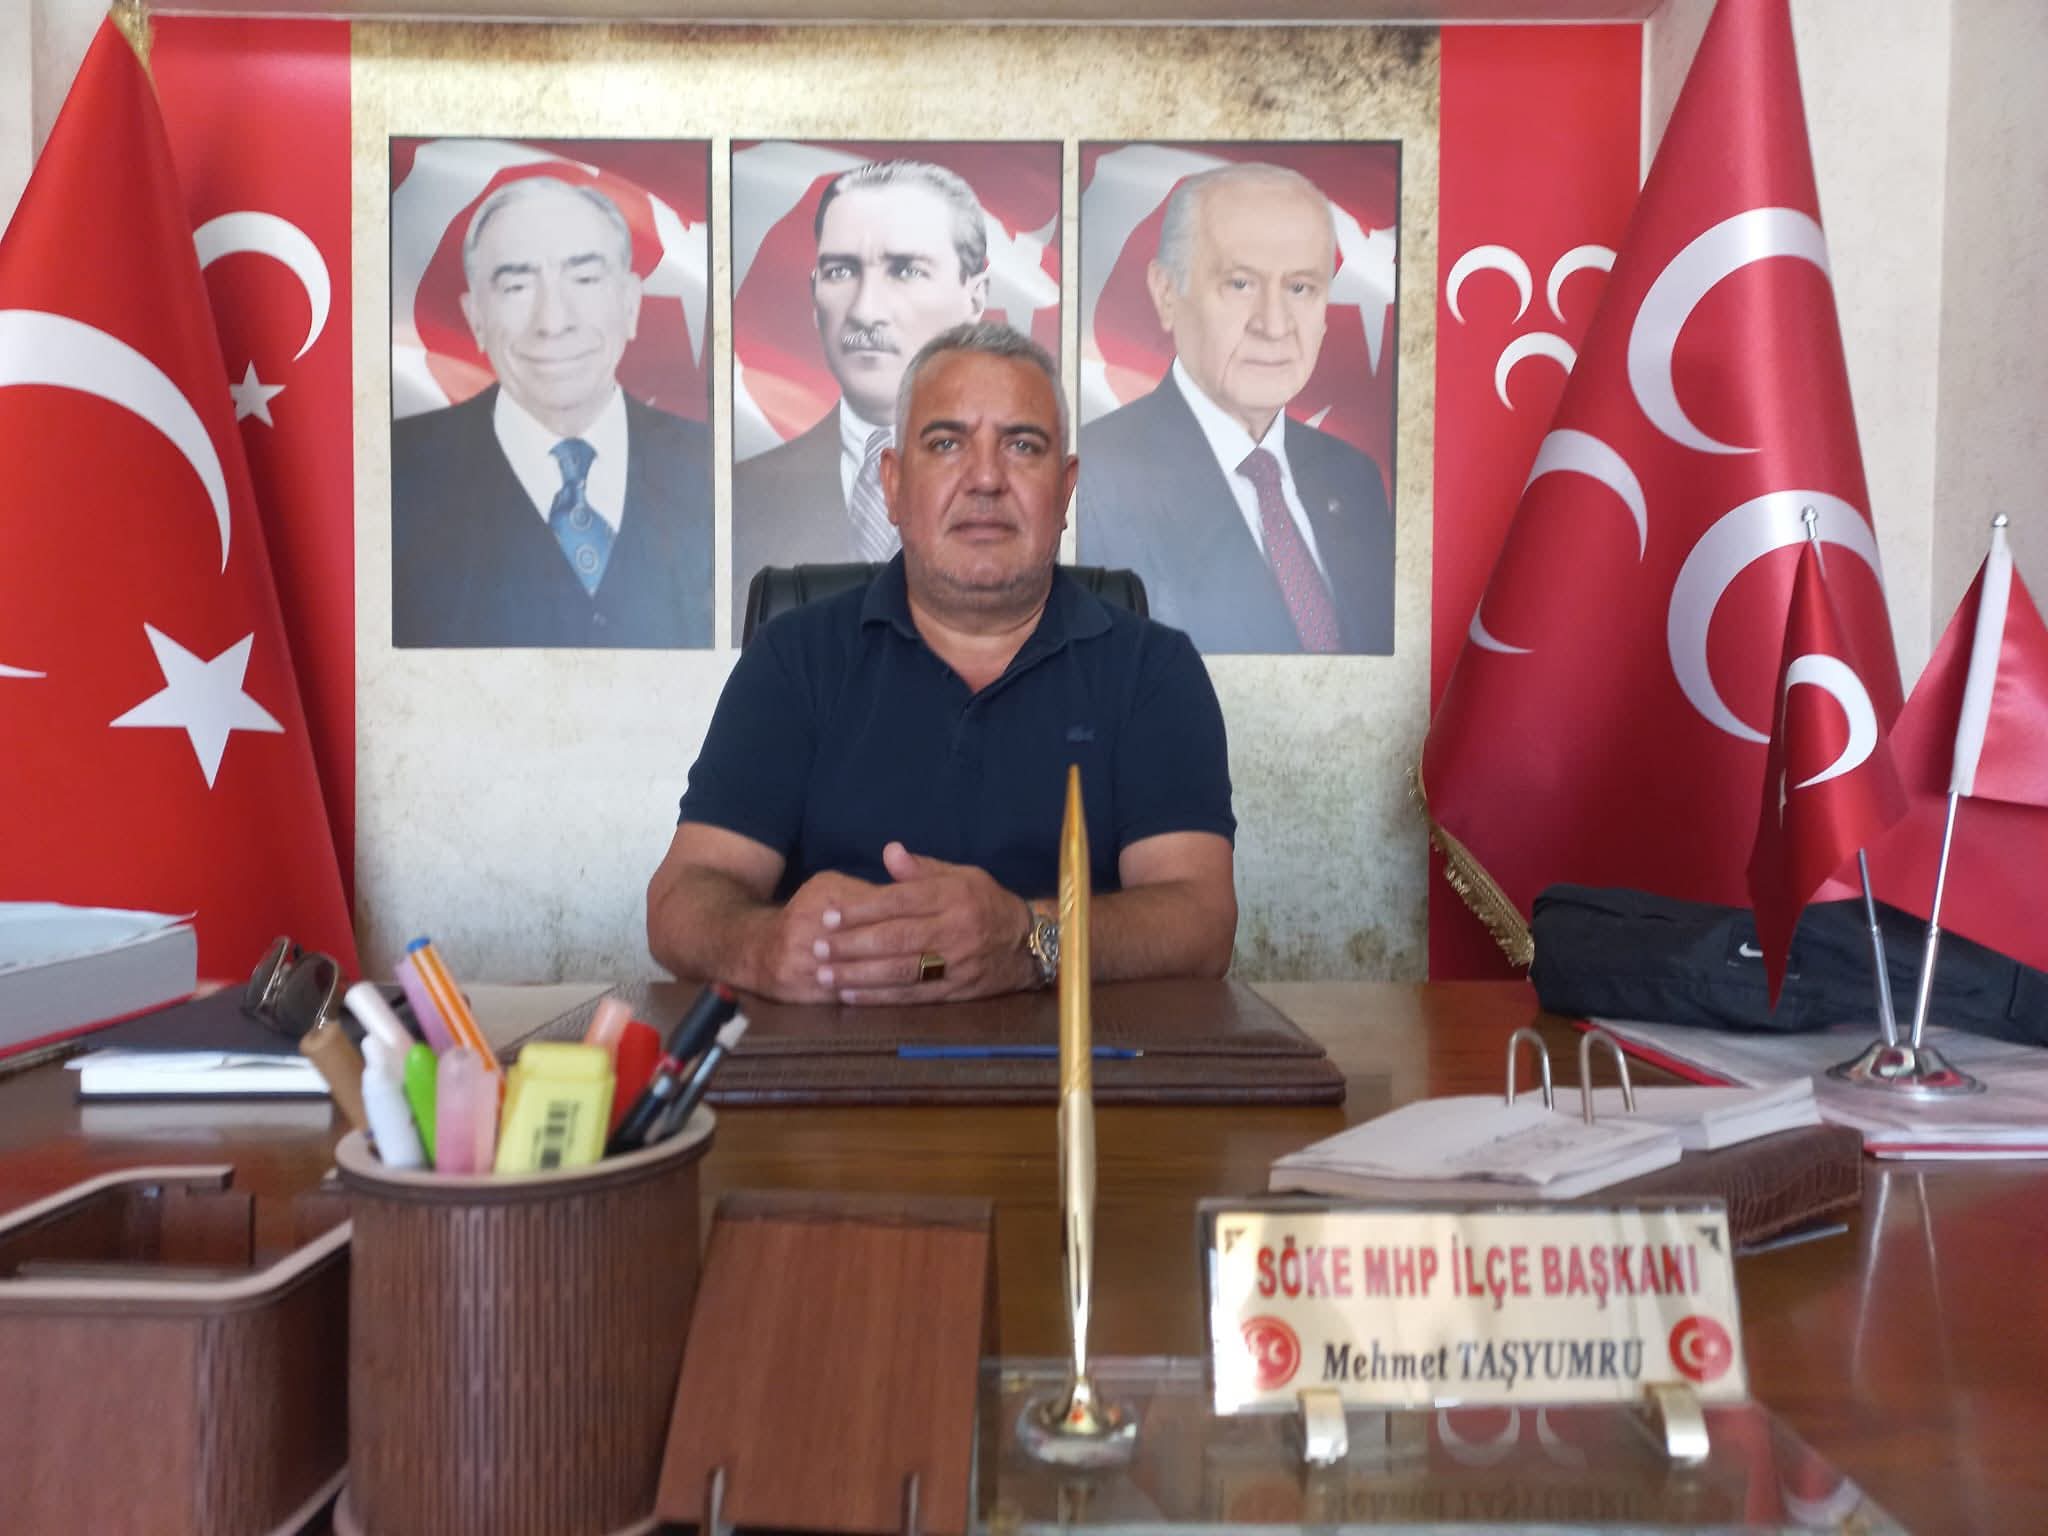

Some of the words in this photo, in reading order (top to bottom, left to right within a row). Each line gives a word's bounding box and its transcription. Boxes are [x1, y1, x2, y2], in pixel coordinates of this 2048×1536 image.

[1258, 1235, 1351, 1298] SÖKE
[1364, 1246, 1438, 1295] MHP
[1452, 1234, 1530, 1310] İLÇE
[1544, 1246, 1699, 1309] BAŞKANI
[1322, 1342, 1448, 1383] Mehmet
[1456, 1341, 1645, 1390] TAŞYUMRU
